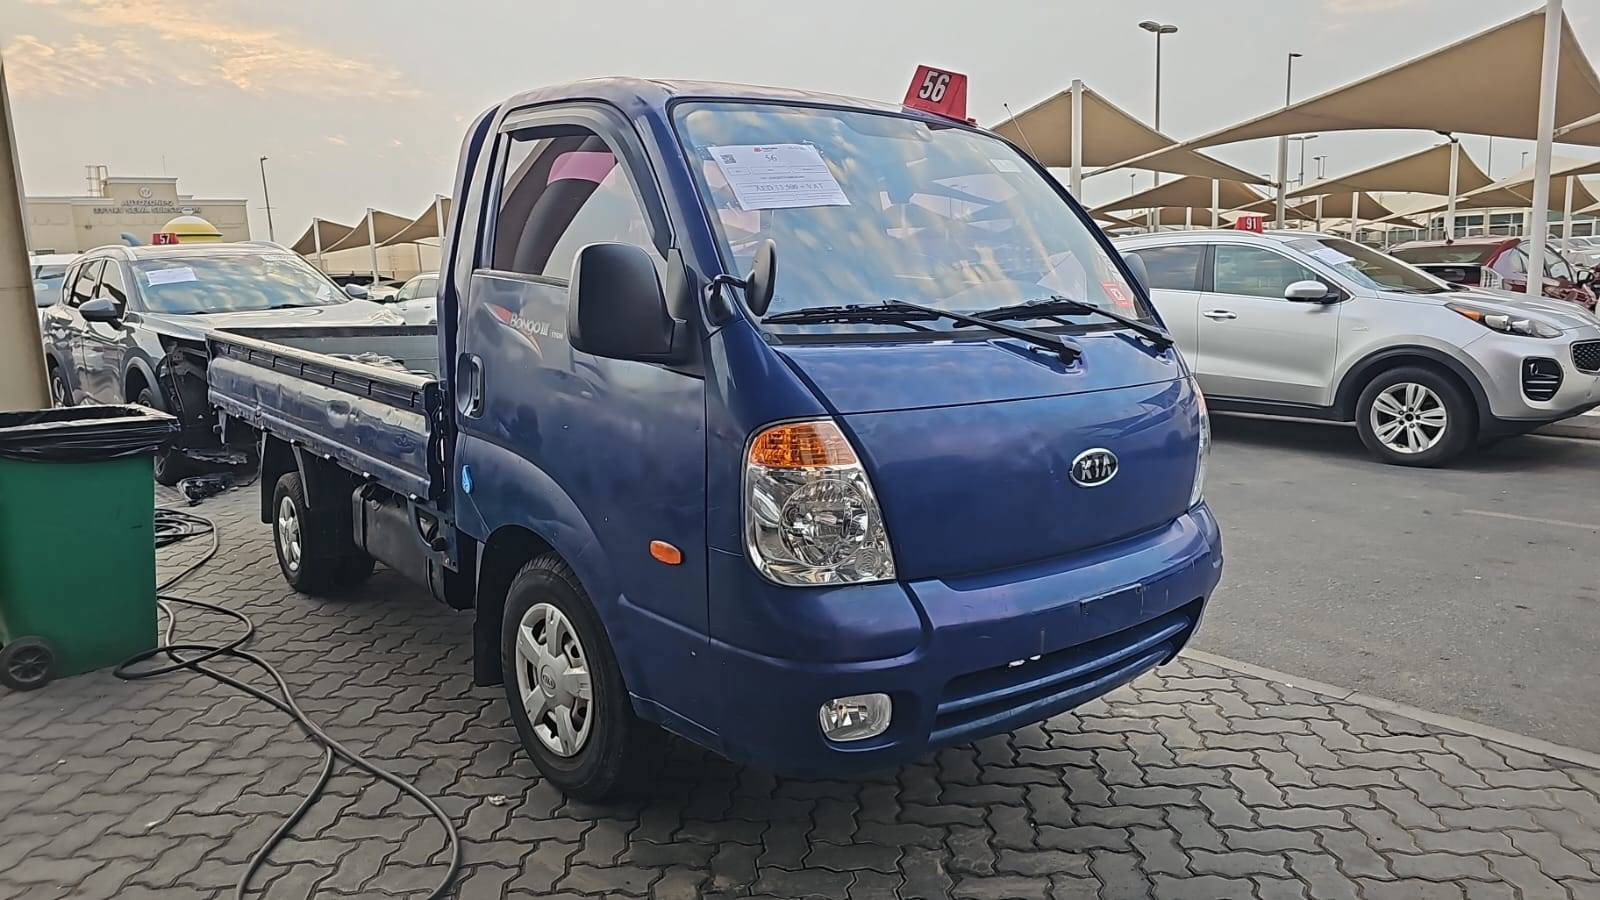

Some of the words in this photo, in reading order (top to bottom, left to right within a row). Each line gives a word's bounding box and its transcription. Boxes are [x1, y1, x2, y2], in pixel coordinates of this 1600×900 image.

[919, 71, 950, 102] 56
[1246, 217, 1257, 230] 91
[160, 234, 170, 244] 57
[1080, 454, 1112, 481] KIA
